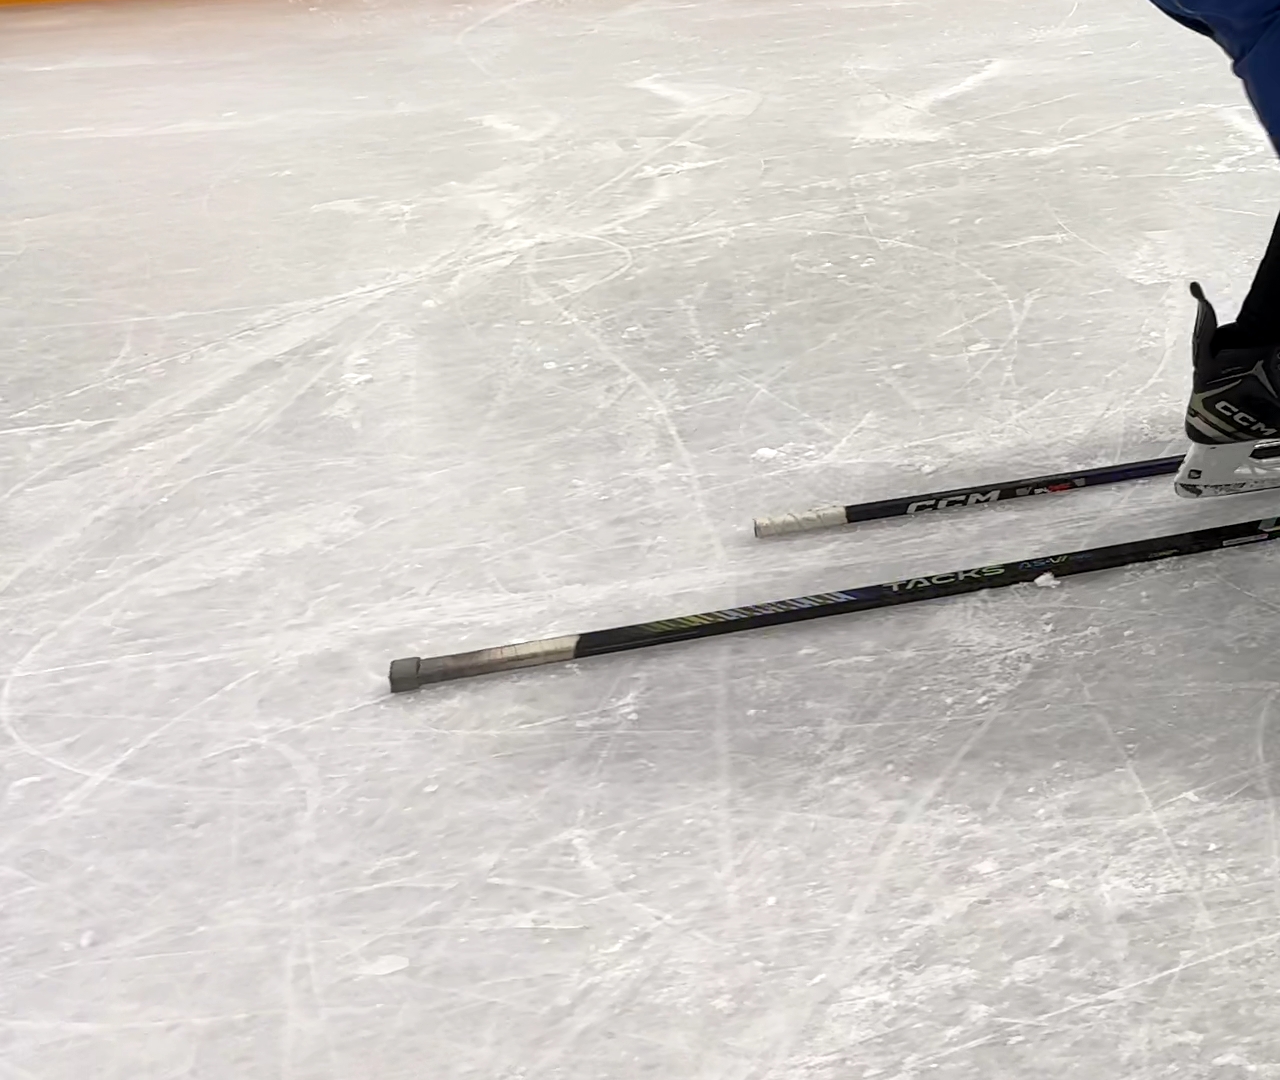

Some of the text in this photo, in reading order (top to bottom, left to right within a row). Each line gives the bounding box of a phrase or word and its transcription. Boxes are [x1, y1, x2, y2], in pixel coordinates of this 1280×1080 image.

[1215, 400, 1278, 436] CCM
[906, 489, 1001, 514] CCM
[883, 565, 1005, 591] TACKS
